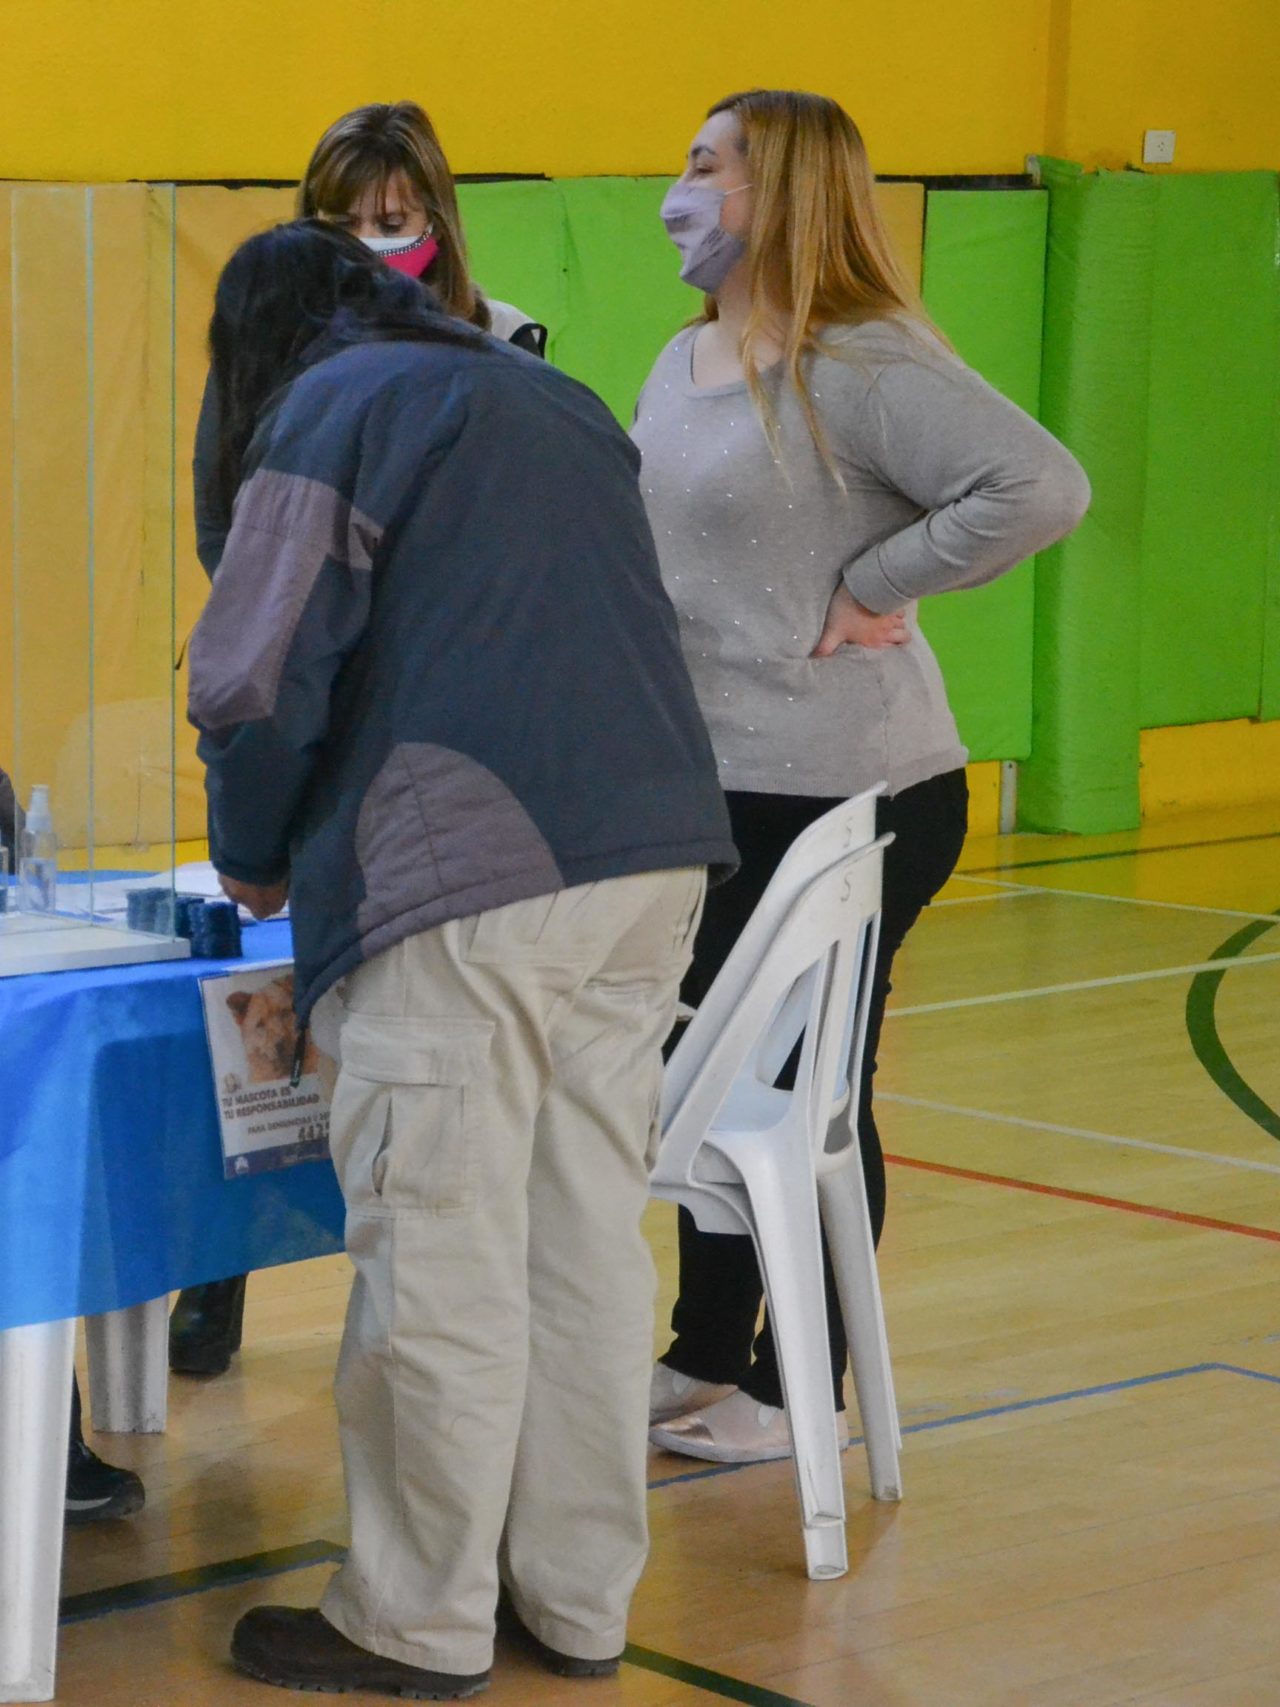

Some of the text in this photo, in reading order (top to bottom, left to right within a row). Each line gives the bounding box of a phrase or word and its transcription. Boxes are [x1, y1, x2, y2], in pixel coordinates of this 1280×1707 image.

[222, 1086, 292, 1107] TU MASCOTA ES
[224, 1109, 235, 1120] TU
[236, 1093, 320, 1117] RESPONSABILIDAD
